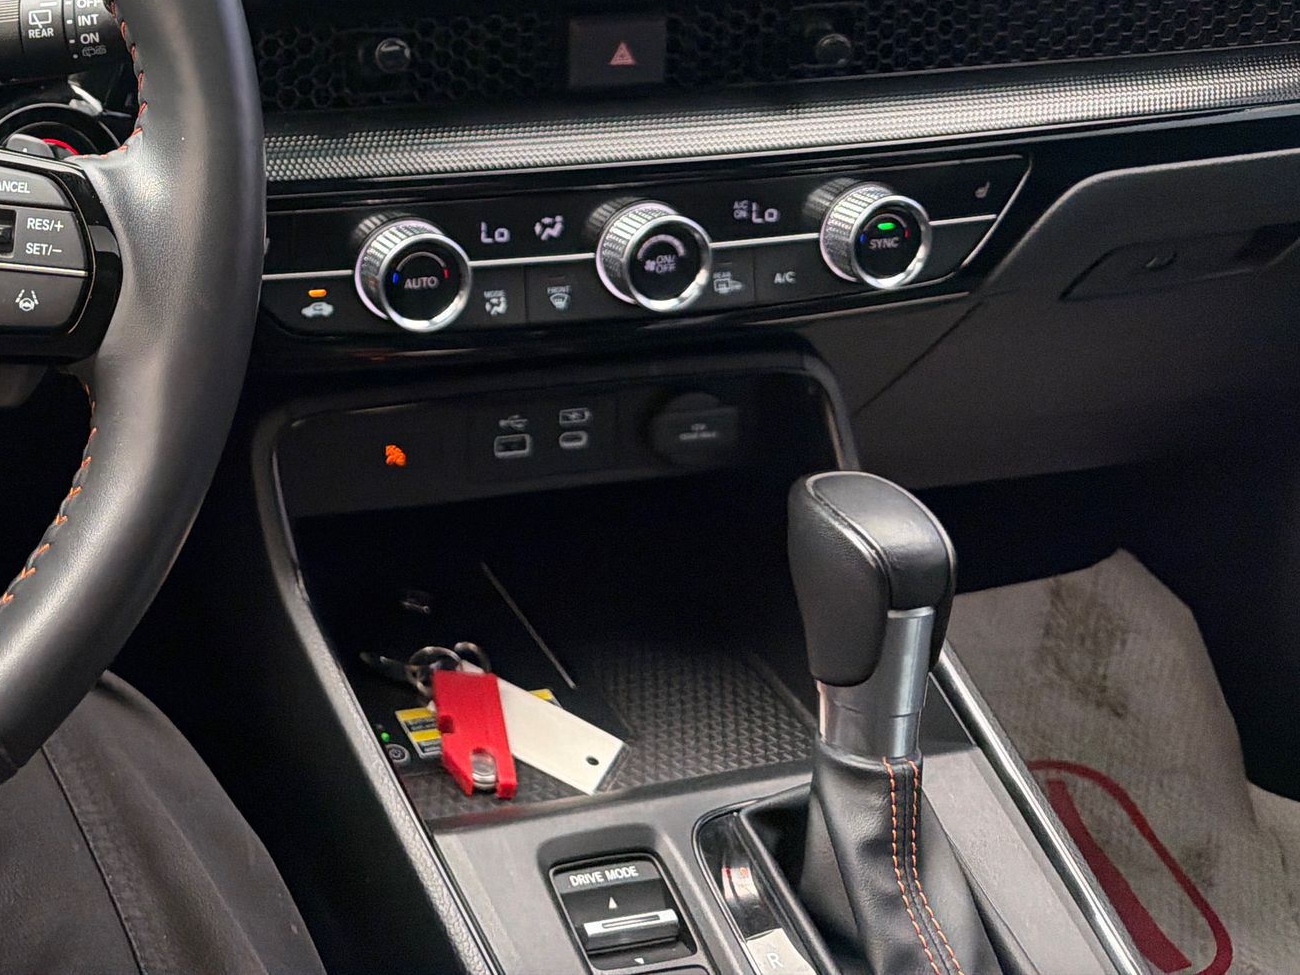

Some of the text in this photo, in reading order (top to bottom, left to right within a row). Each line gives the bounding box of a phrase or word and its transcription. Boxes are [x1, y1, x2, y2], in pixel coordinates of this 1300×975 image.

[78, 14, 99, 26] INT
[28, 28, 54, 39] REAR
[80, 32, 100, 44] ON
[27, 218, 64, 232] RES/+
[869, 236, 899, 249] SYNC
[656, 263, 677, 274] OFF
[403, 276, 439, 290] AUTO
[773, 271, 796, 284] A/C
[569, 866, 639, 887] DRIVE MODE
[767, 952, 783, 969] R
